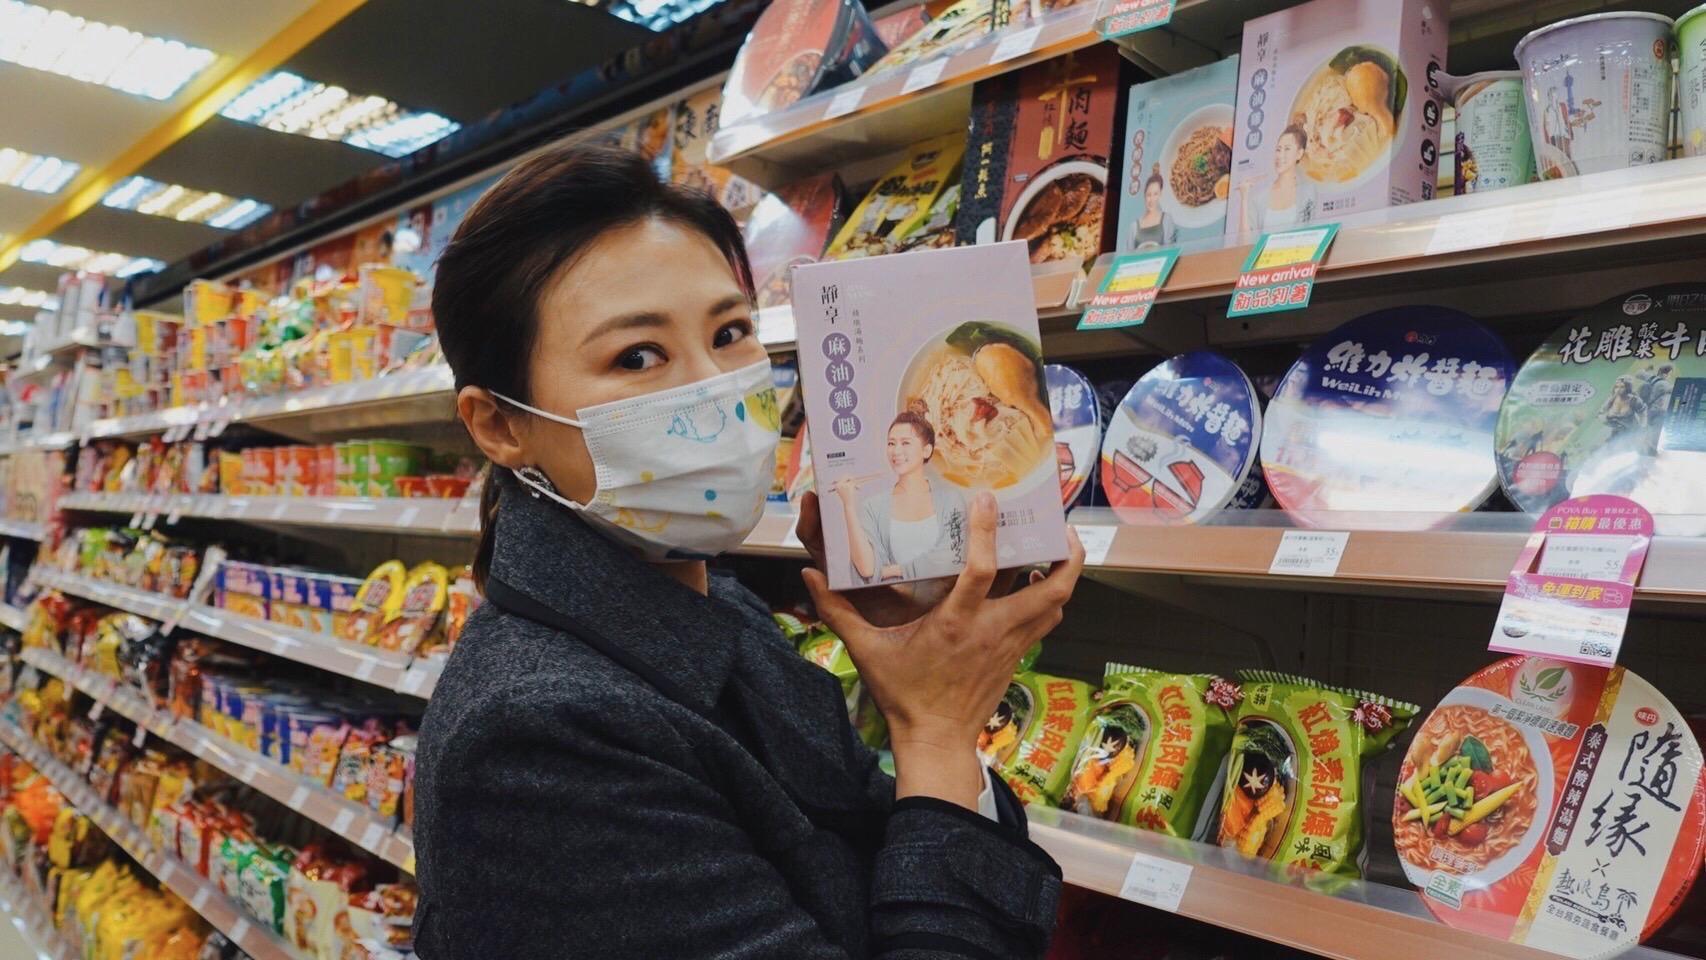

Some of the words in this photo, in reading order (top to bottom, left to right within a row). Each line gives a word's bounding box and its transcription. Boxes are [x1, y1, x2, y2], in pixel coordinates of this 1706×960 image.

[1092, 293, 1116, 306] New
[1117, 288, 1156, 303] arrival
[1239, 273, 1269, 287] New
[1271, 264, 1315, 282] arrival
[827, 336, 857, 436] 麻油雞腿
[1322, 376, 1372, 398] WeiLih
[1323, 340, 1498, 398] 維力炸醬麵
[1297, 703, 1338, 838] 紅燒素肉燥
[1551, 732, 1605, 845] 泰式酸辣湯麵
[1585, 722, 1683, 857] 隨緣
[1433, 874, 1462, 897] 全素
